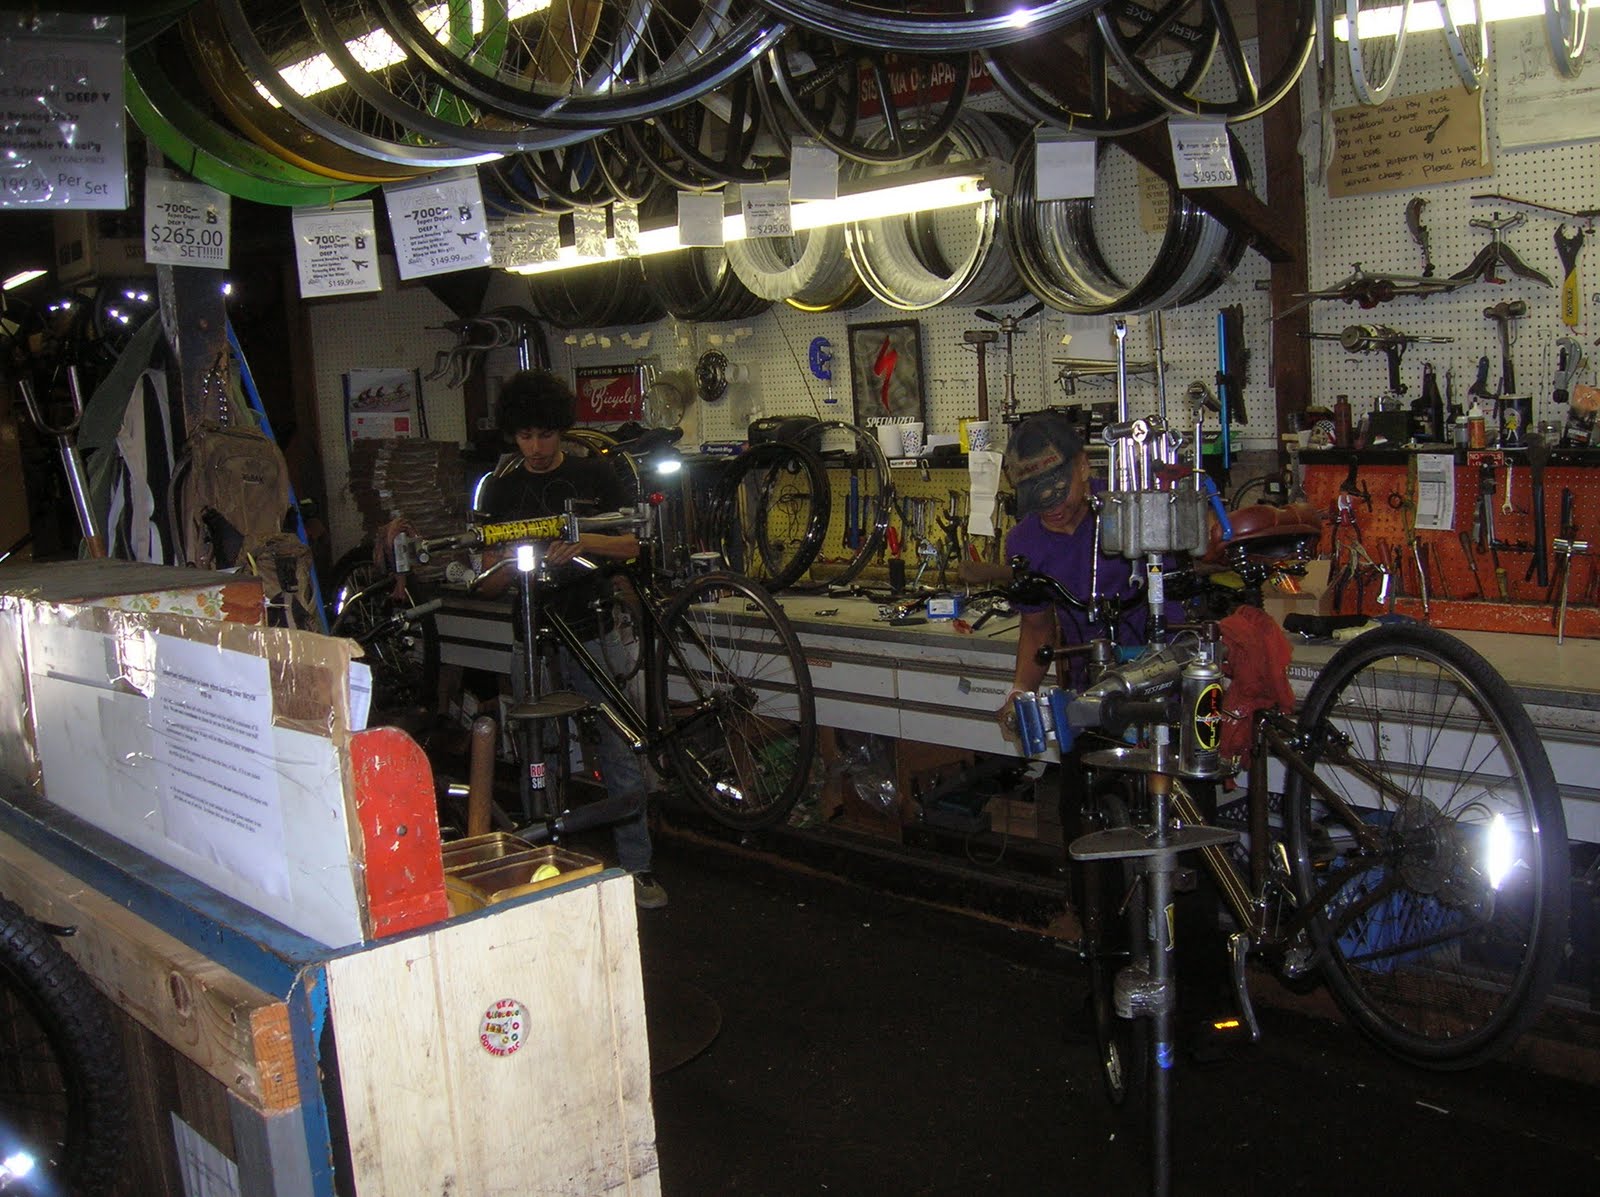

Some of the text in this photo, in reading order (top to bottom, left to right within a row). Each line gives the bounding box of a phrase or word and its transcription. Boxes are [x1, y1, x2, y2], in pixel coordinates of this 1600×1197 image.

[65, 92, 99, 103] DEEP
[57, 141, 102, 152] Veocity
[58, 173, 81, 188] Per
[84, 181, 108, 194] Set
[433, 215, 452, 223] Duper
[151, 224, 223, 246] $265.00
[430, 254, 460, 266] $149.99
[591, 386, 637, 413] Bicycles
[865, 416, 915, 428] SPECIALIZED
[484, 518, 561, 545] AMOEBA MUSIC
[496, 1000, 507, 1009] BE
[480, 1034, 506, 1056] DONATE
